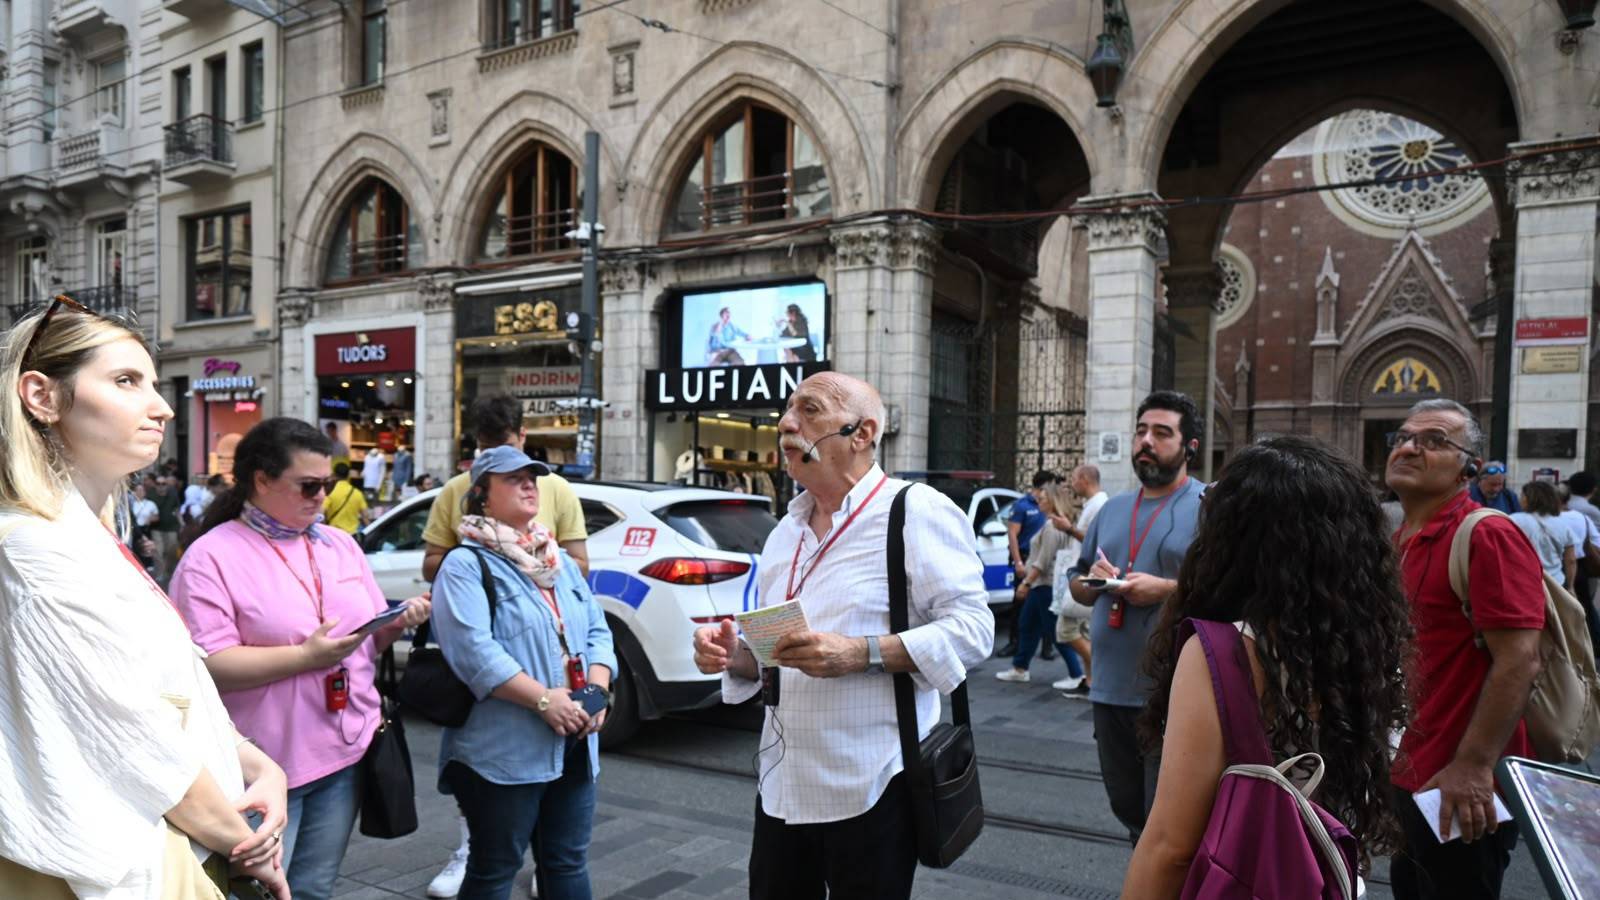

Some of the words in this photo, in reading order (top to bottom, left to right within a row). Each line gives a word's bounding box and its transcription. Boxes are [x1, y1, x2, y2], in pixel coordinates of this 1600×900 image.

[495, 300, 558, 334] ESQ
[337, 344, 386, 363] TUDORS
[193, 376, 253, 390] ACCESSORIES
[659, 366, 803, 403] LUFIAN
[629, 529, 652, 546] 112
